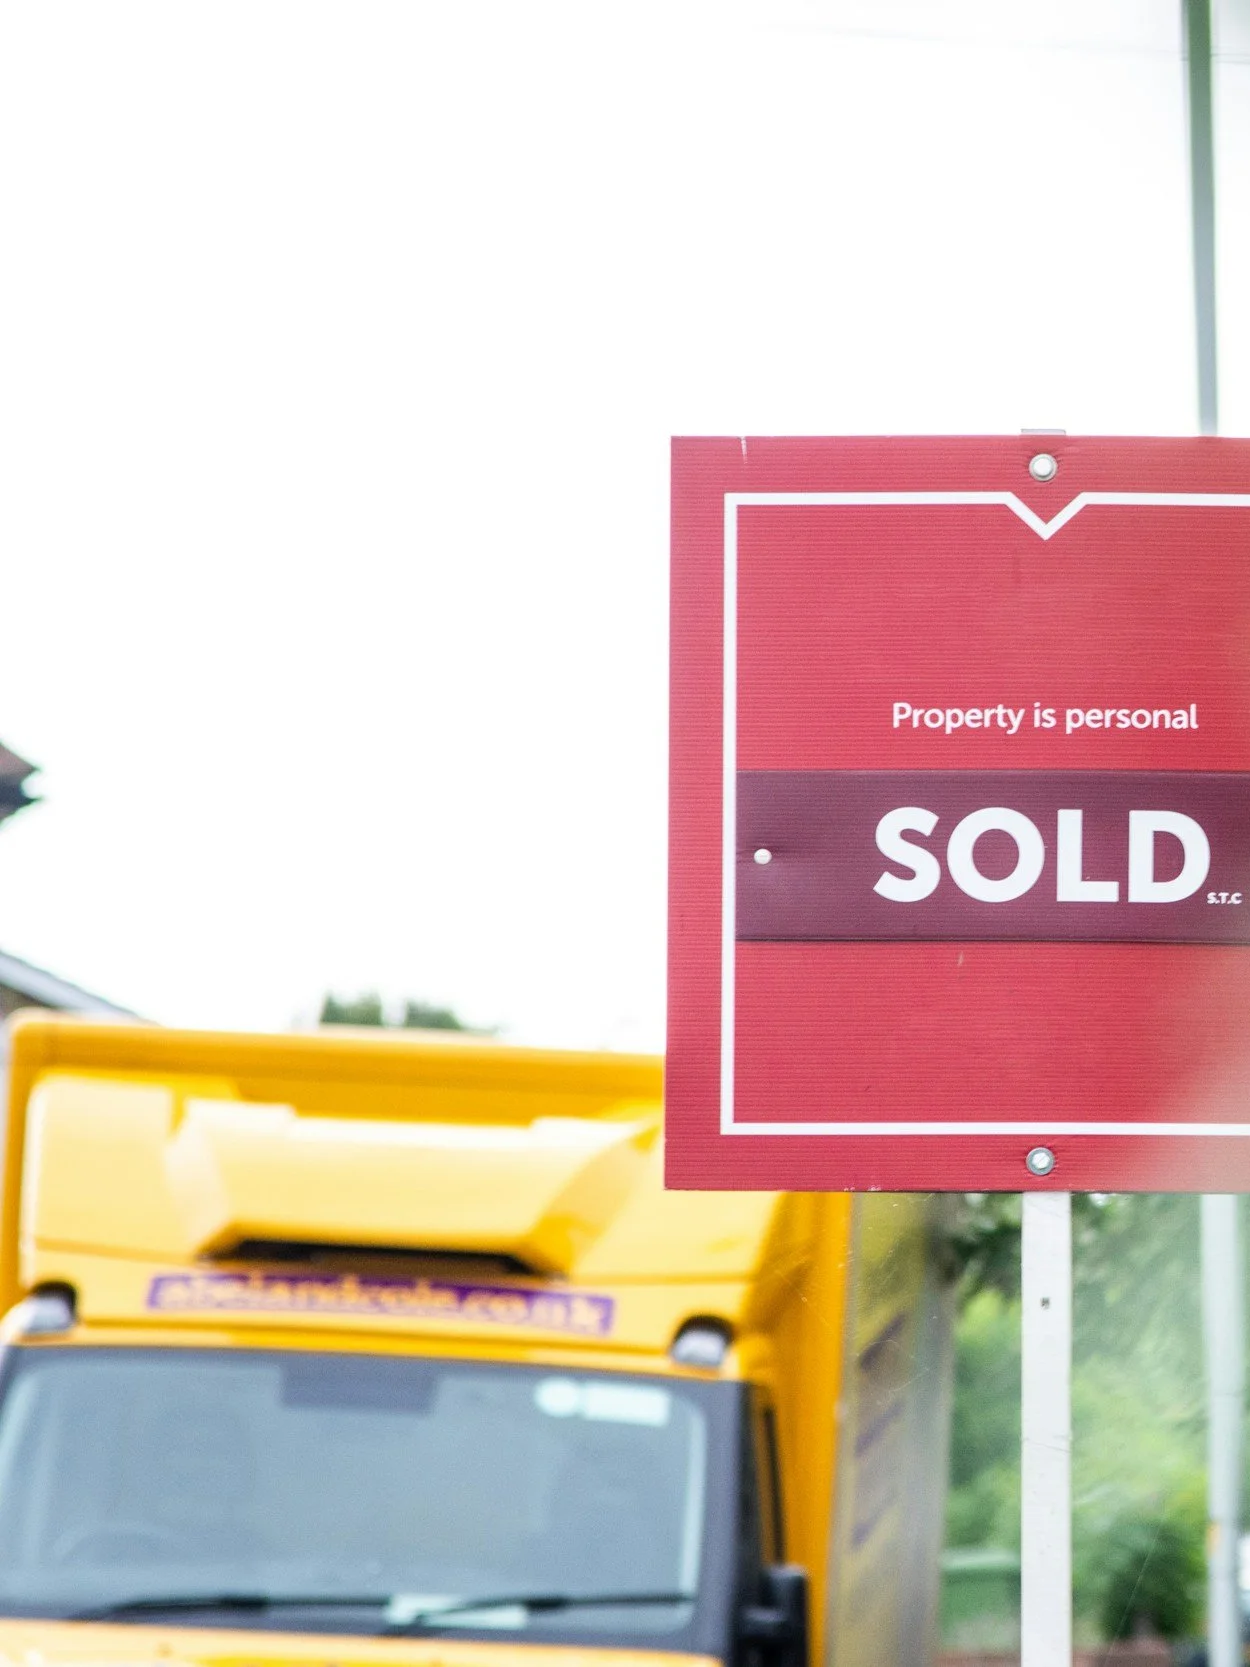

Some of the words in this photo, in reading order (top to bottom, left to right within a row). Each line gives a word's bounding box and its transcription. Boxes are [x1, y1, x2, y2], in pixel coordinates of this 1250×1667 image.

[892, 701, 1026, 735] Property
[1033, 701, 1057, 729] is
[1065, 703, 1199, 735] personal
[872, 806, 1212, 904] SOLD
[1206, 891, 1243, 905] S.T.C
